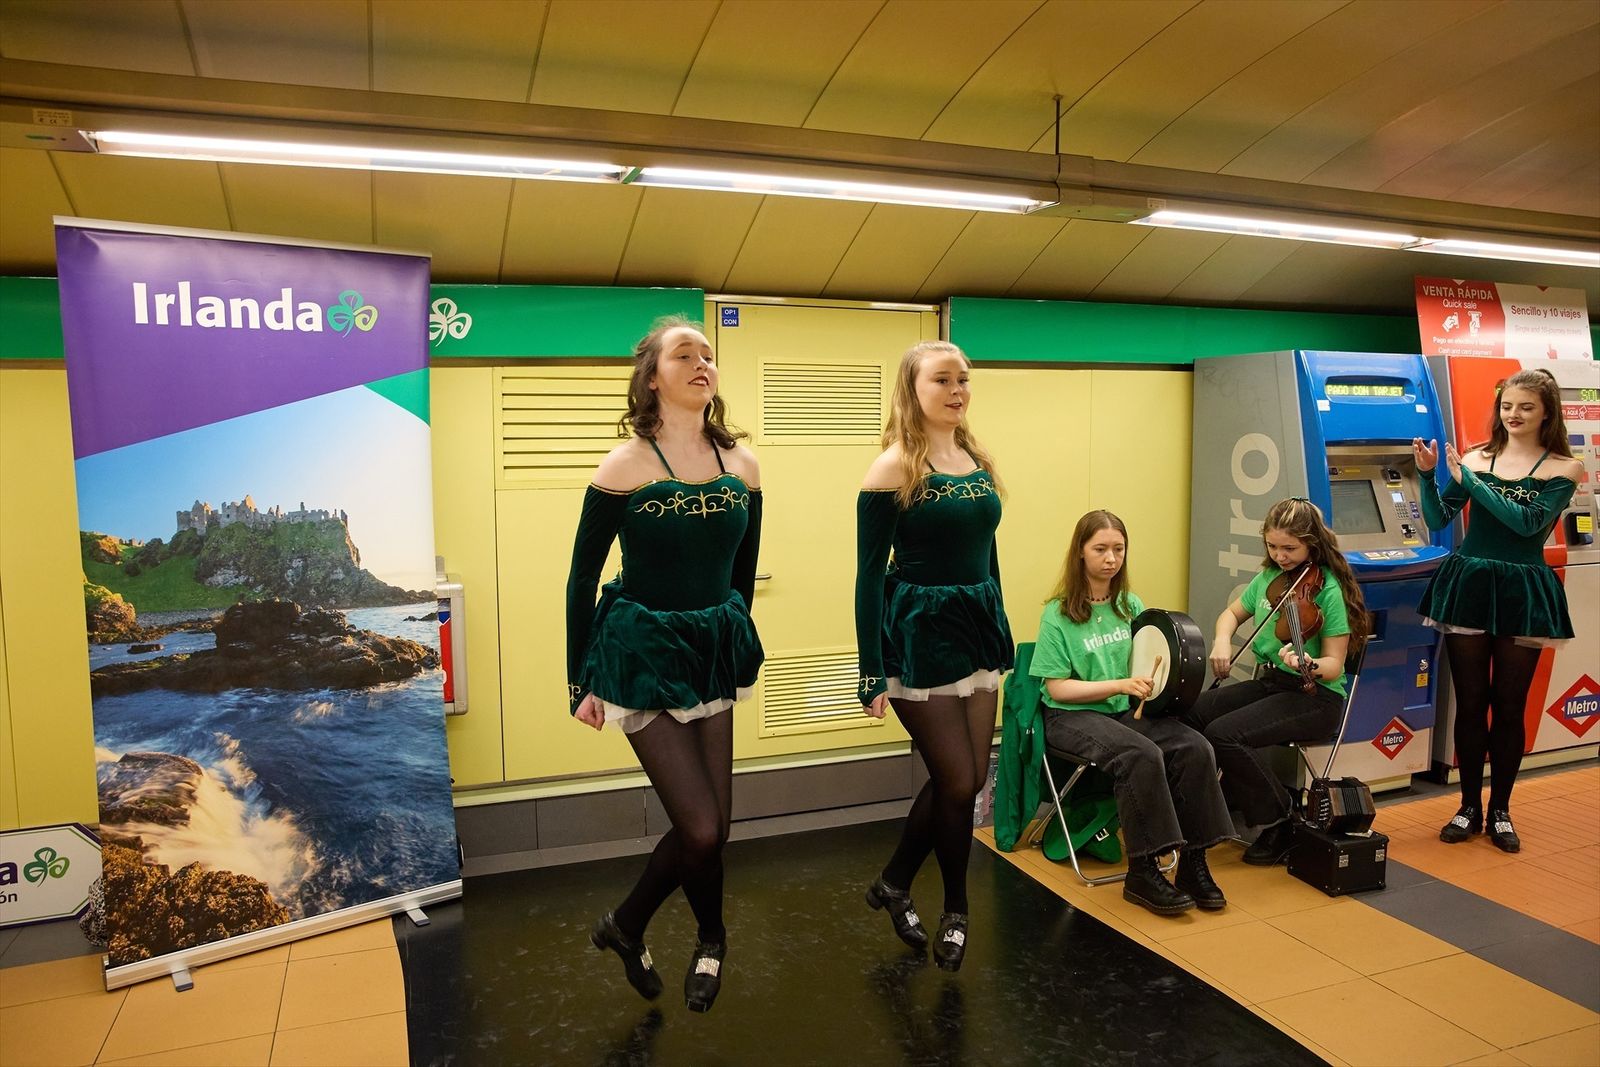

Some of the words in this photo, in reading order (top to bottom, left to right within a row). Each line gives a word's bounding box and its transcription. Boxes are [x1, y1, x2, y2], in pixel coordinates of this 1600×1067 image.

[1423, 285, 1455, 298] VENTA
[1458, 287, 1493, 300] RÁPIDA
[133, 281, 323, 332] Irlanda
[1443, 299, 1462, 308] Quick
[1464, 301, 1477, 309] sale
[1511, 305, 1541, 316] Sencillo
[1543, 310, 1548, 318] y
[1550, 308, 1558, 317] 10
[1560, 308, 1581, 319] viajes
[1326, 385, 1349, 395] PAGO
[1353, 386, 1369, 395] CON
[1083, 627, 1129, 651] Irlanda
[1567, 700, 1598, 715] Metro
[1383, 735, 1403, 745] Metro
